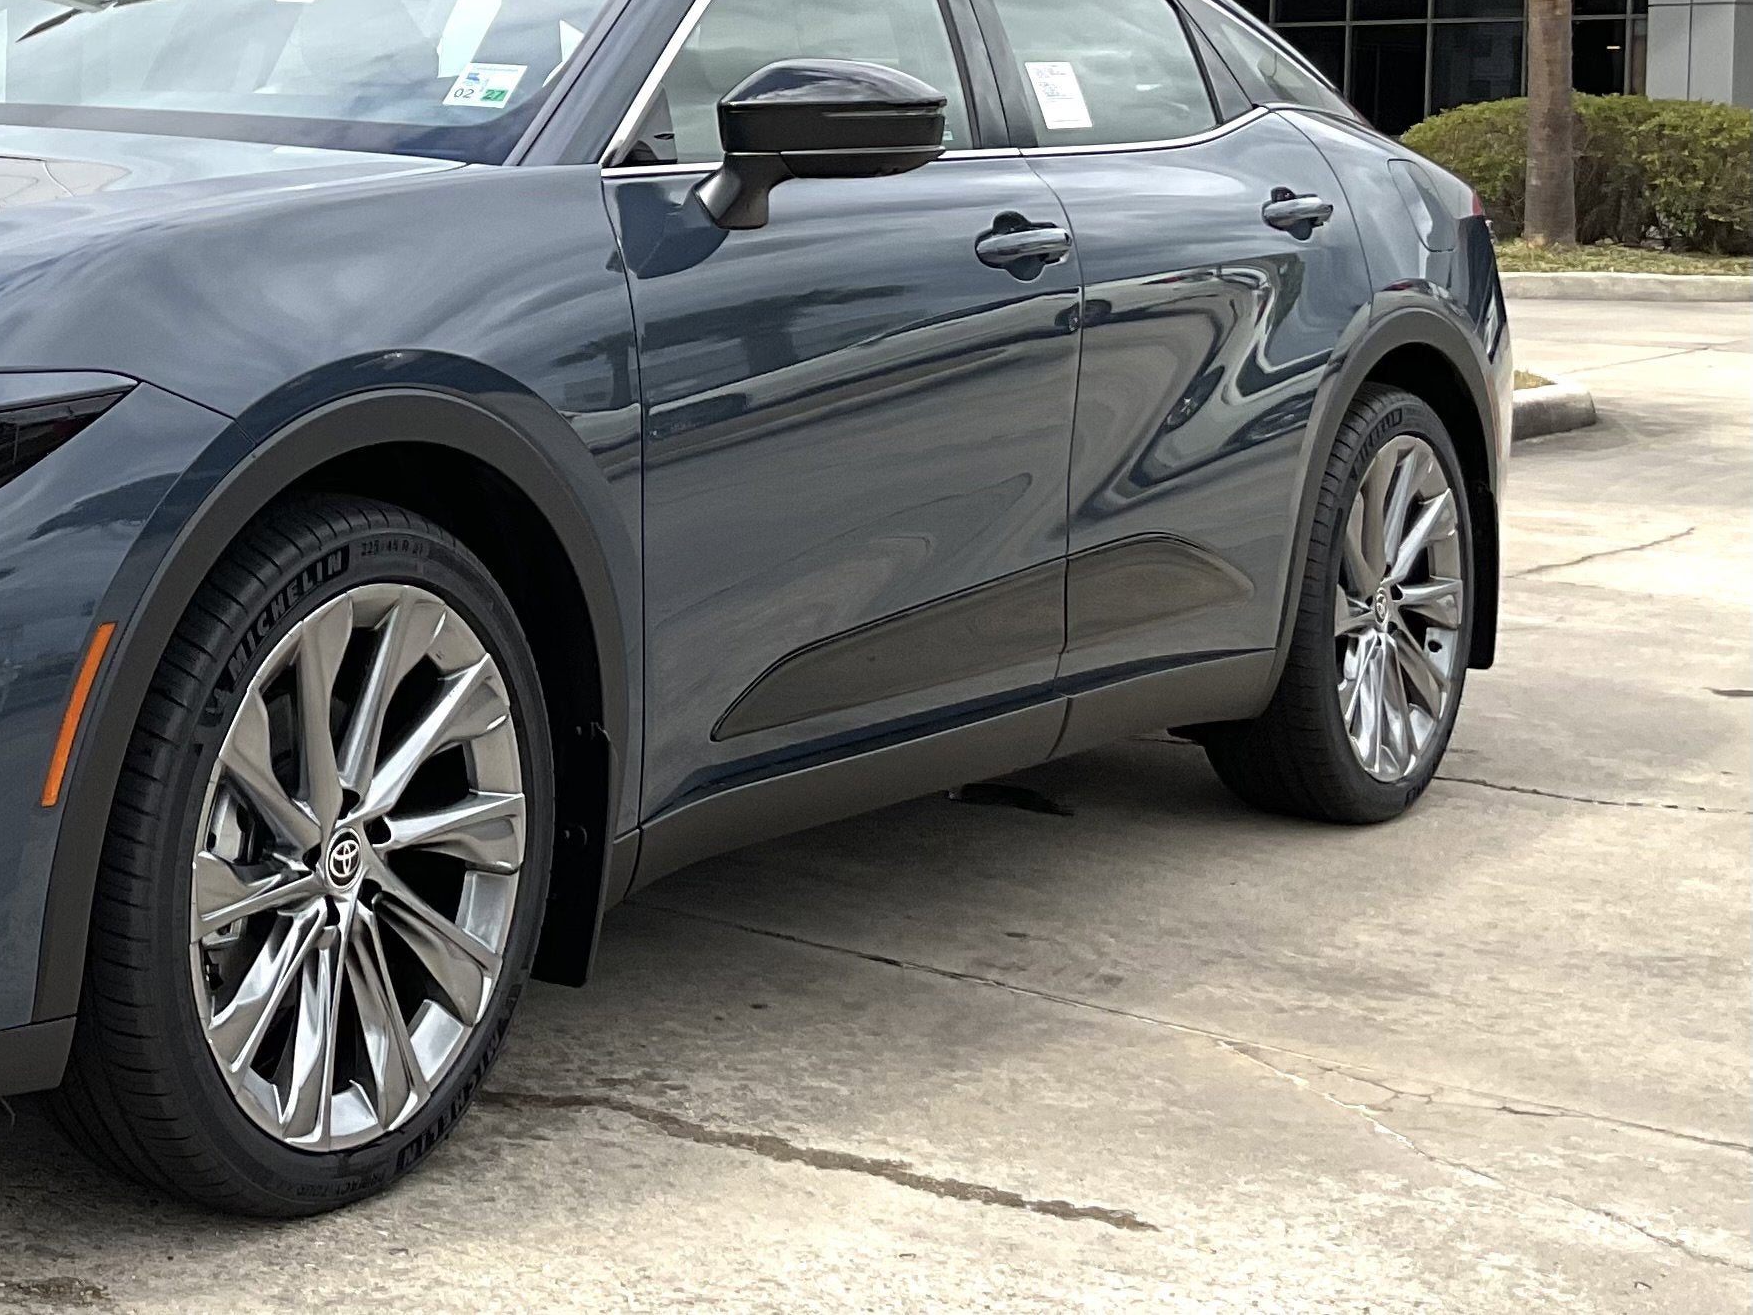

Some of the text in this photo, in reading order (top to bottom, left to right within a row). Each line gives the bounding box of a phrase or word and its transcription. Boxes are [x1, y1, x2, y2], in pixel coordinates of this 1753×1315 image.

[453, 88, 505, 101] 02 27
[227, 550, 343, 682] MICHELIN
